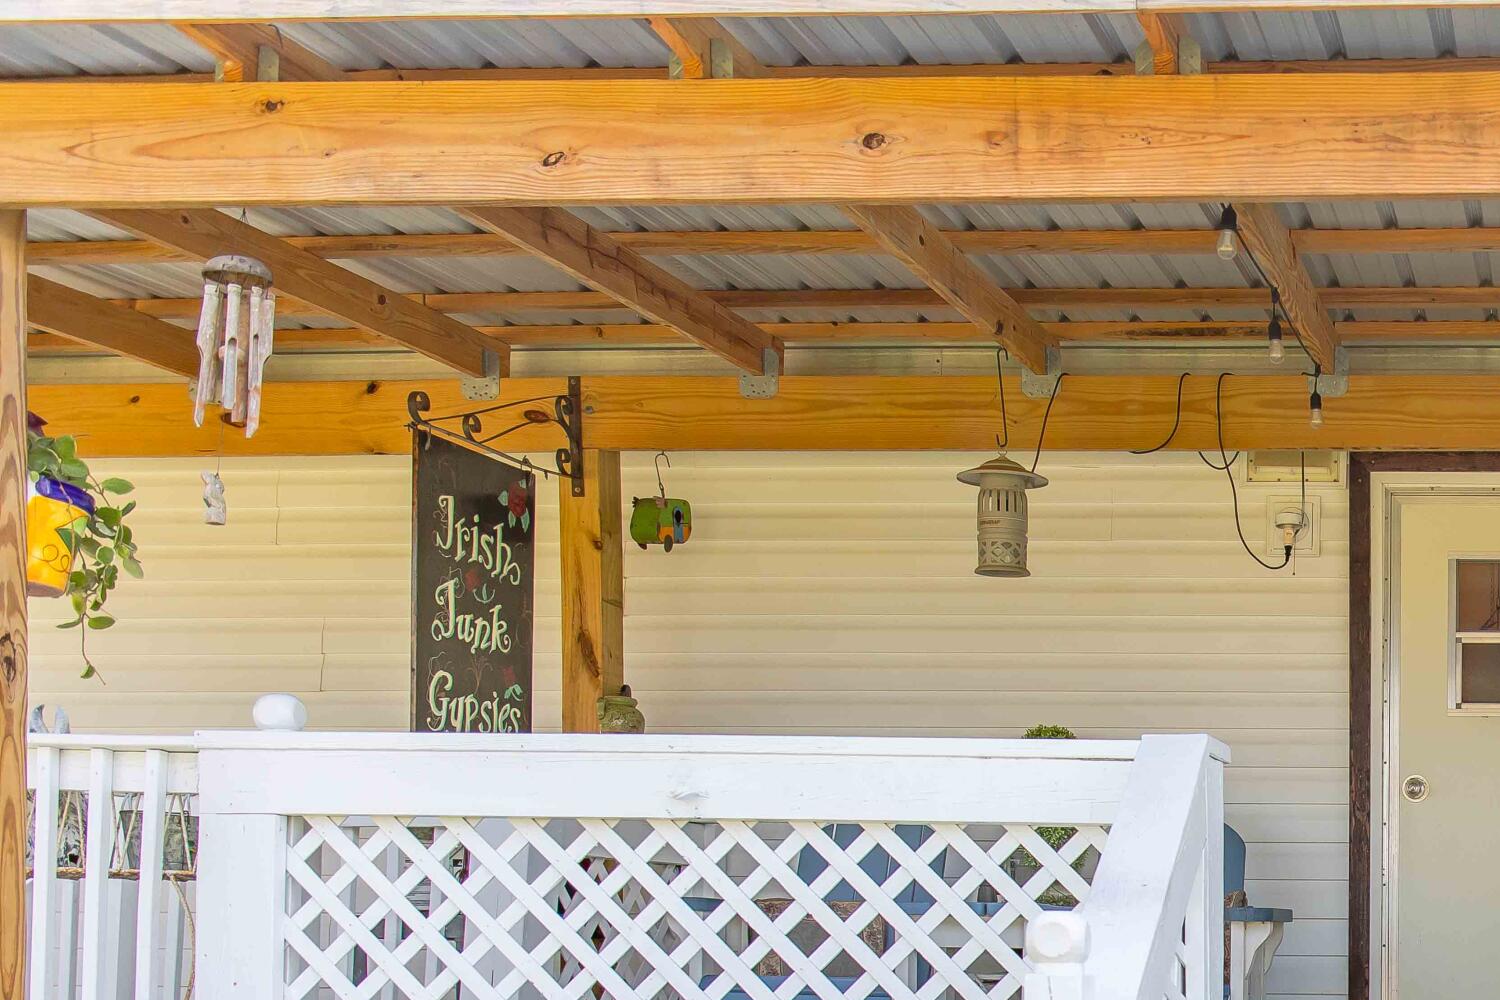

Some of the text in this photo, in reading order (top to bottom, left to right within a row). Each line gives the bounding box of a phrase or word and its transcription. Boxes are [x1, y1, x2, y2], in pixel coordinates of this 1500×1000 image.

[437, 495, 519, 585] Irish
[432, 577, 511, 654] Junk
[427, 669, 521, 732] Gypsies
